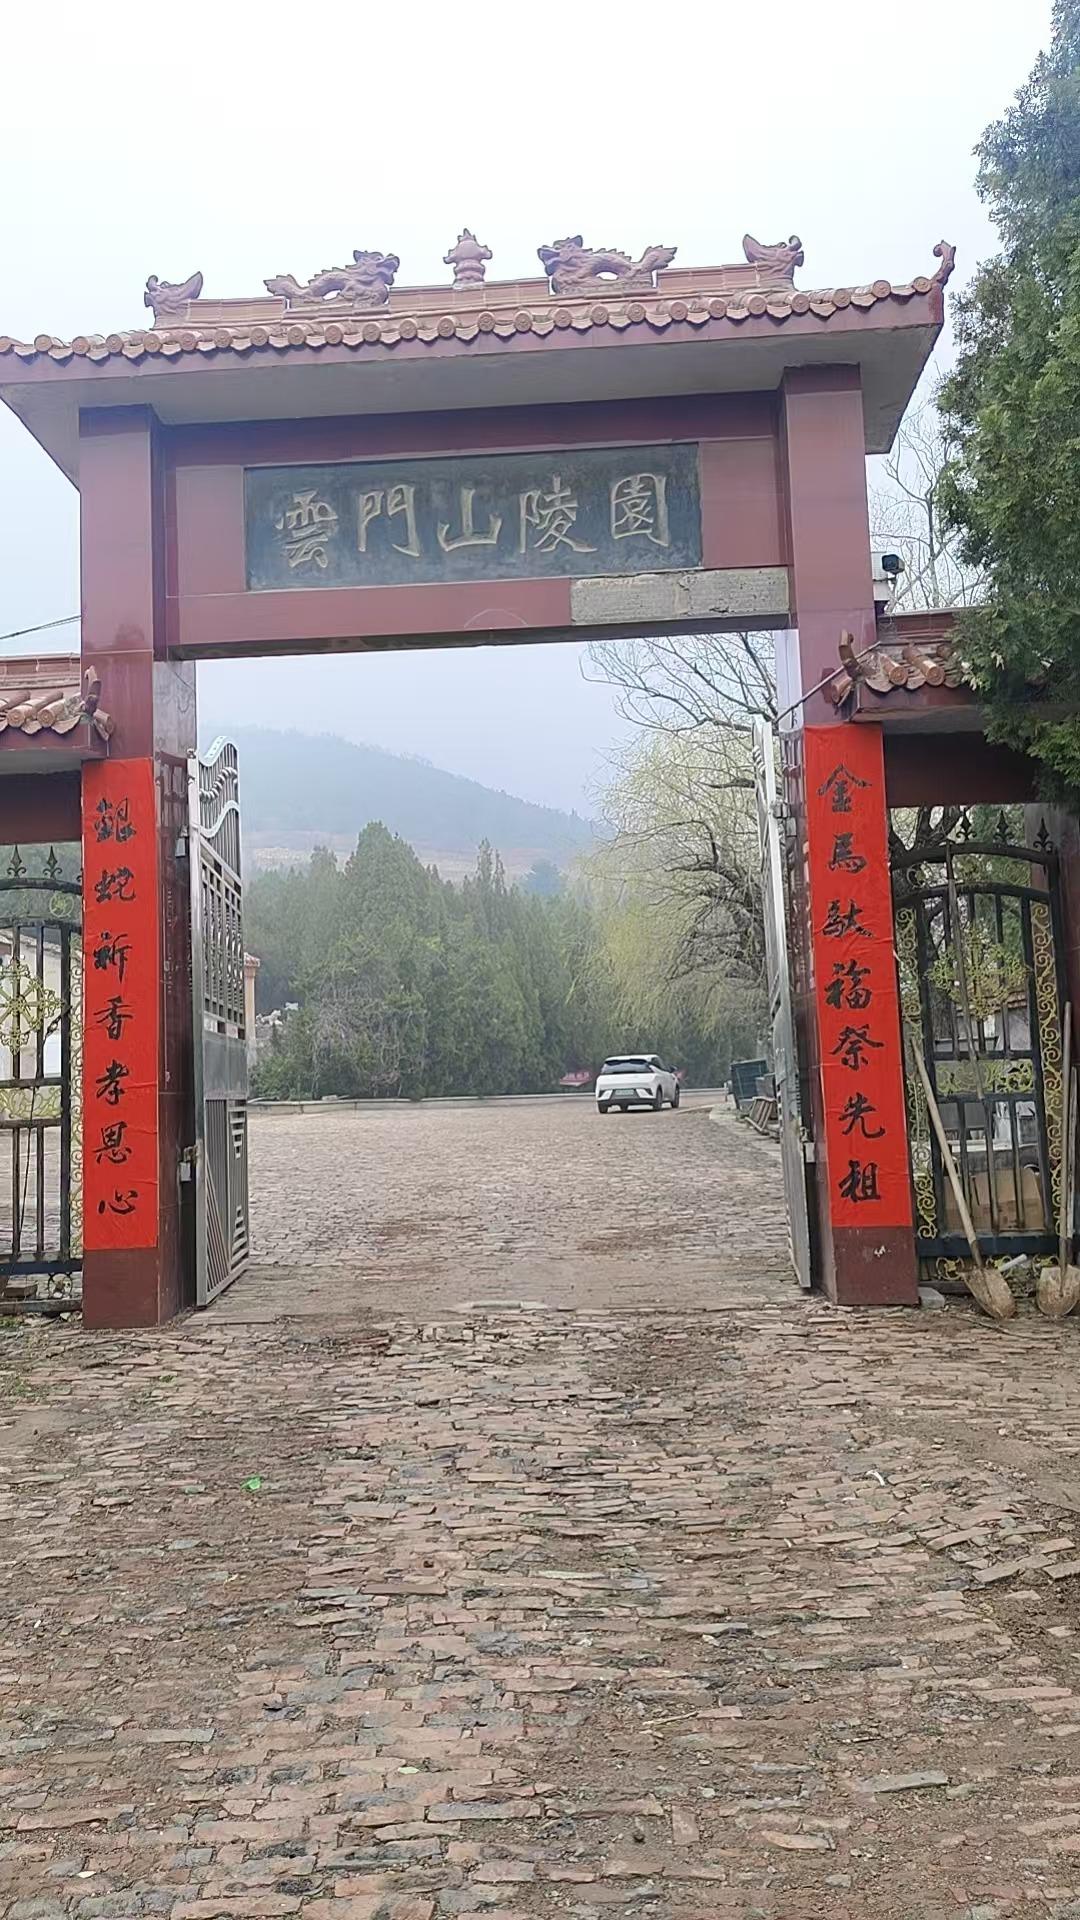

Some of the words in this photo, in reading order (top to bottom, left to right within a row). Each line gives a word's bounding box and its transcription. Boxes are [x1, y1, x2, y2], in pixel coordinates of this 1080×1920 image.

[275, 473, 671, 568] 雲門山陵園
